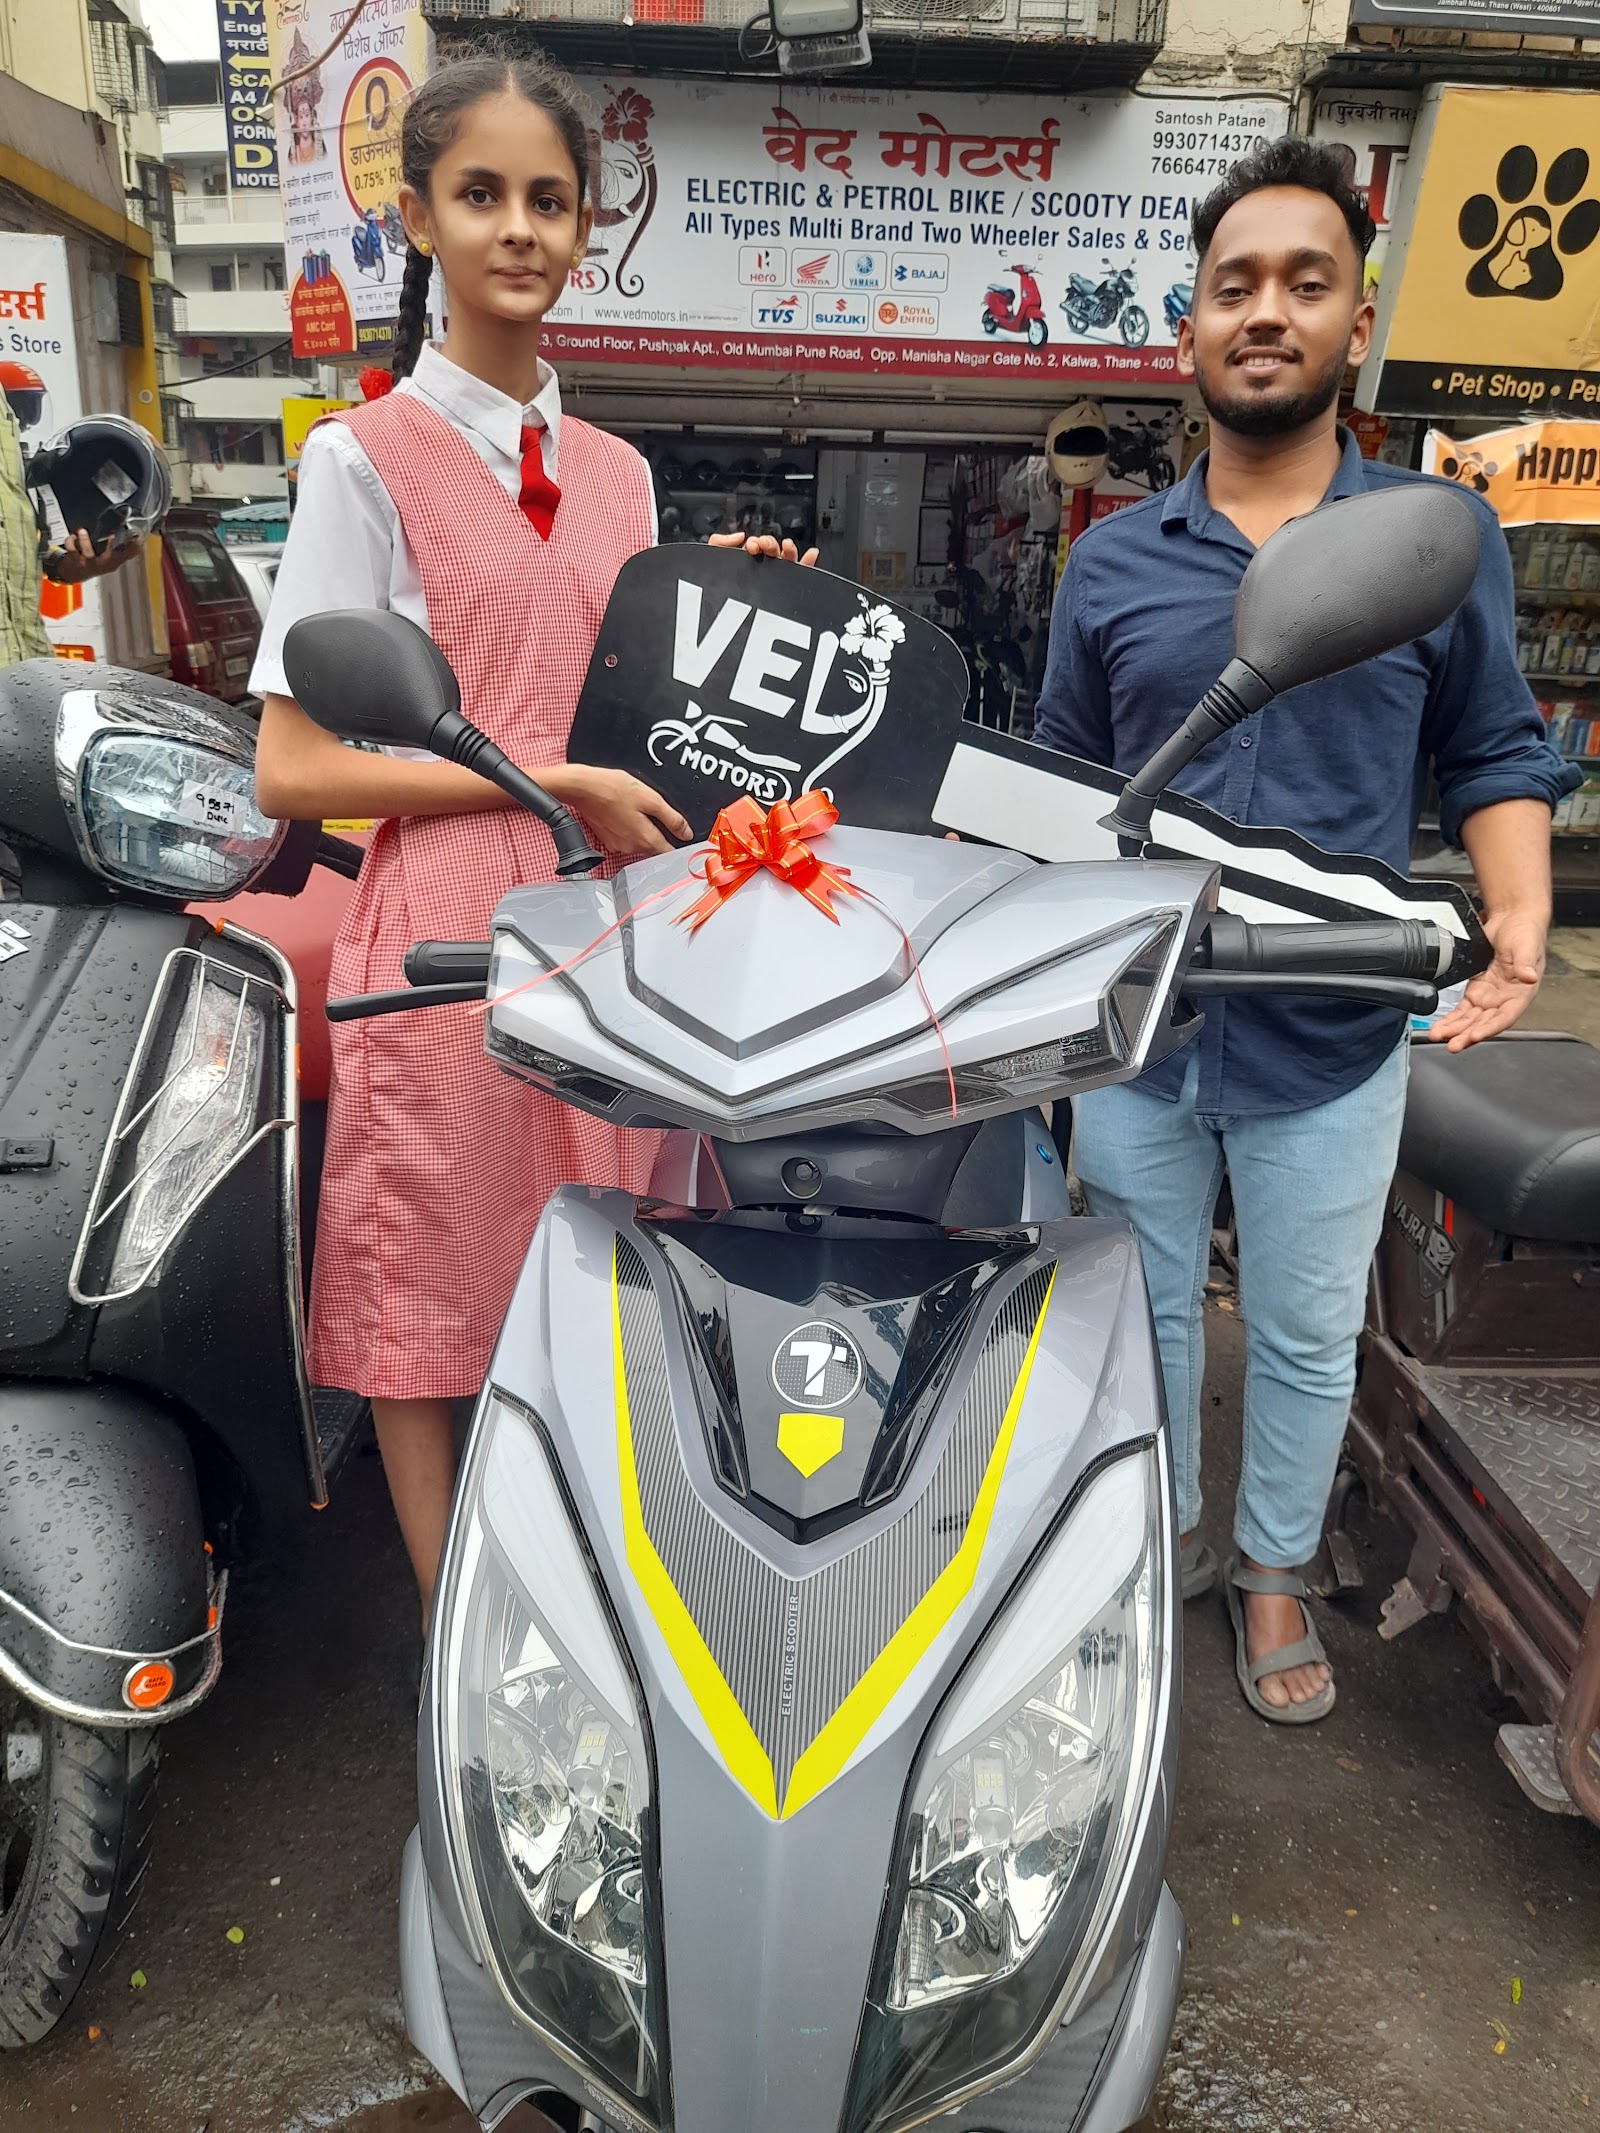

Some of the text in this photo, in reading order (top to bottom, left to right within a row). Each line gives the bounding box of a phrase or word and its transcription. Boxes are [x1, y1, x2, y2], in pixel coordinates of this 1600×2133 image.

[1488, 2, 1510, 10] Thane
[343, 21, 405, 61] विशेष ऑफर
[230, 91, 257, 104] A4
[1154, 111, 1266, 128] Santosh Patane
[762, 106, 1060, 182] वेद मोटर्स
[234, 144, 278, 169] D
[687, 178, 806, 207] ELECTRIC
[816, 184, 833, 208] &
[844, 185, 939, 212] PETROL
[949, 189, 1006, 215] BIKE
[1031, 191, 1132, 219] SCOOTY
[685, 211, 712, 234] All
[721, 213, 781, 240] Types
[789, 216, 843, 240] Multi
[851, 218, 913, 242] Brand
[921, 221, 961, 245] Two
[970, 223, 1059, 248] Wheeler
[1067, 226, 1125, 249] Sales
[1135, 230, 1149, 250] &
[750, 273, 777, 284] Hero
[797, 278, 830, 286] HONDA
[849, 278, 879, 288] YAMAHA
[911, 269, 945, 280] BAJAJ
[594, 306, 689, 323] www.vedmotors.in
[758, 308, 794, 323] TVS
[903, 305, 932, 315] ROYAL
[815, 313, 866, 325] SUZUKI
[900, 315, 935, 325] ENFIELD
[11, 333, 62, 354] Store
[556, 334, 600, 348] Ground
[603, 336, 636, 352] Floor,
[639, 339, 690, 355] Pushpak
[722, 341, 743, 356] Old
[746, 343, 793, 358] Mumbai
[796, 345, 827, 359] Pune
[830, 346, 864, 362] Road,
[870, 348, 899, 365] Opp.
[902, 349, 952, 365] Manisha
[954, 351, 991, 368] Nagar
[993, 352, 1021, 367] Gate
[1024, 353, 1045, 367] No.
[1047, 354, 1059, 369] 2,
[1062, 354, 1101, 370] Kalwa,
[1104, 355, 1141, 370] Thane
[1151, 357, 1175, 371] 400
[1448, 371, 1485, 396] Pet
[1488, 374, 1545, 403] Shop
[679, 746, 778, 800] MOTORS
[1393, 1196, 1426, 1245] VAJRA
[781, 1595, 799, 1717] ELECTRIC SCOOTER
